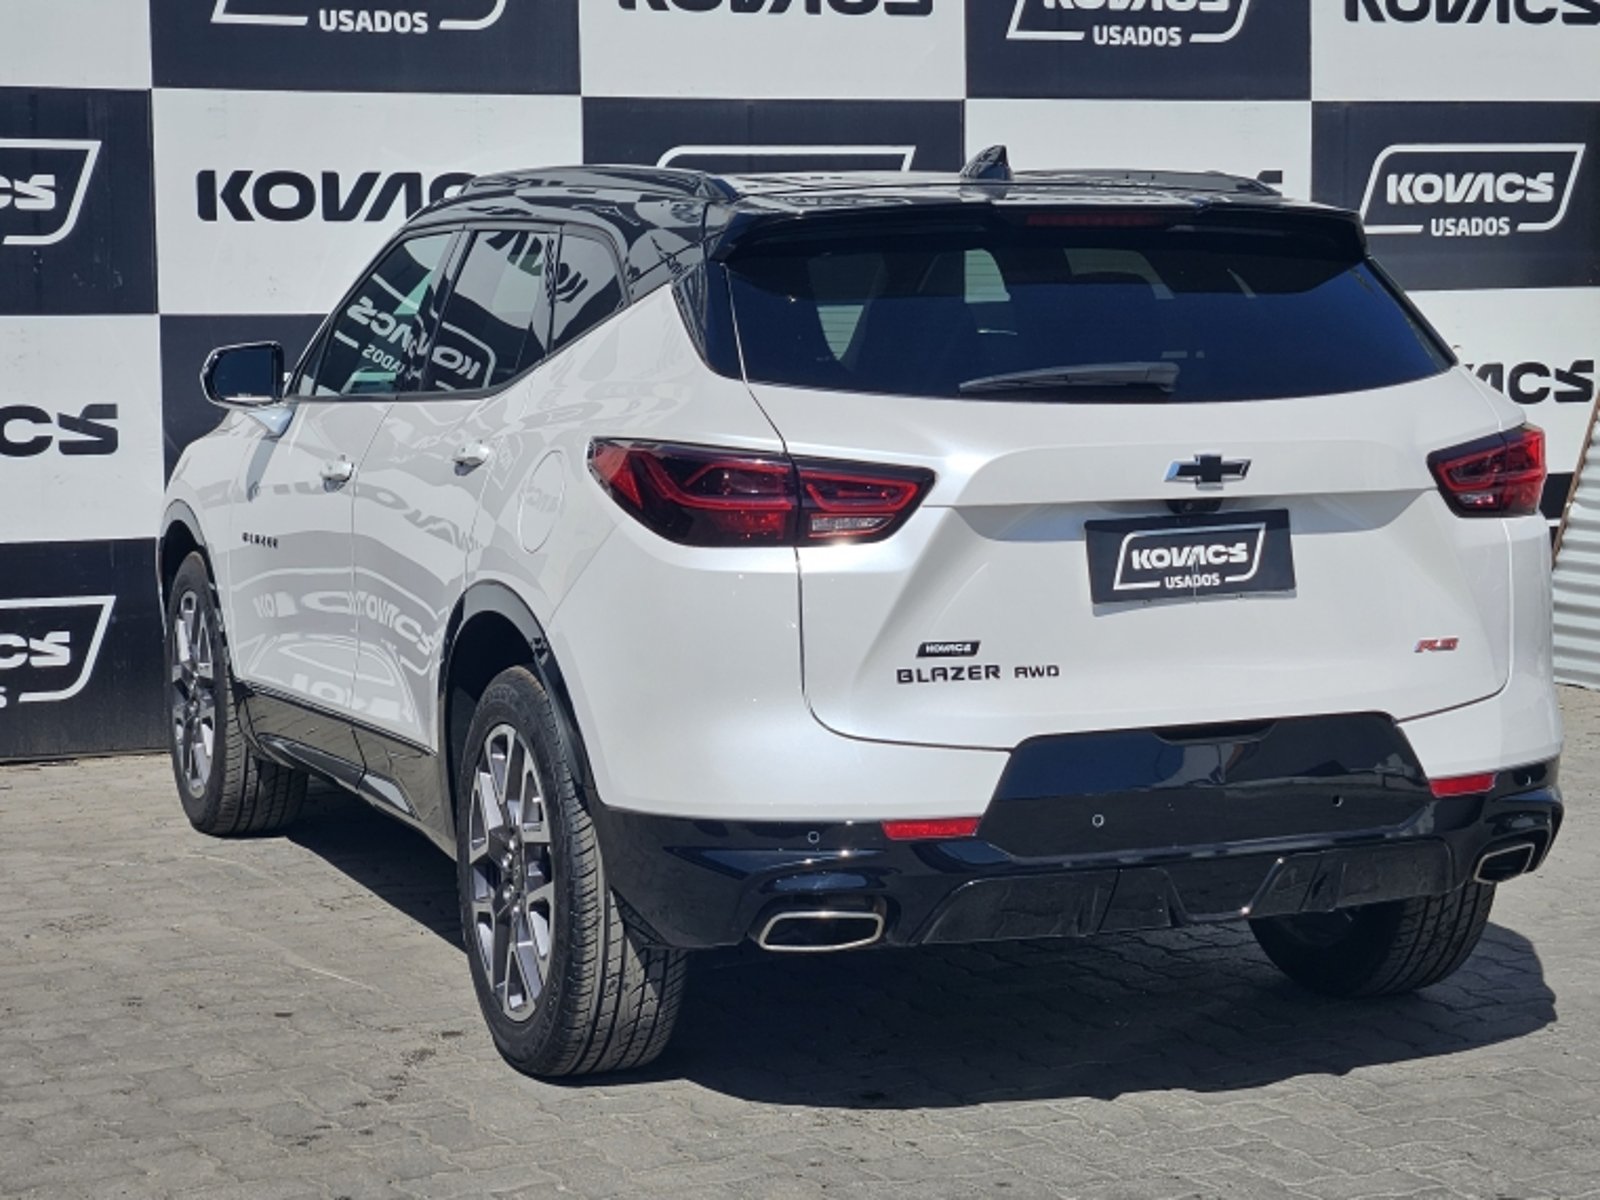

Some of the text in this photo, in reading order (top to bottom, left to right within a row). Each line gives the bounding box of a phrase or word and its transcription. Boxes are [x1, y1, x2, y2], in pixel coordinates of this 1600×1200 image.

[319, 9, 428, 34] USADOS
[1092, 25, 1182, 47] USADOS
[1386, 172, 1555, 205] KOVACS
[1430, 216, 1511, 237] USADOS
[1131, 542, 1249, 570] KOVACS
[1164, 572, 1221, 590] USADOS
[896, 663, 1060, 685] BLAZER AWD
